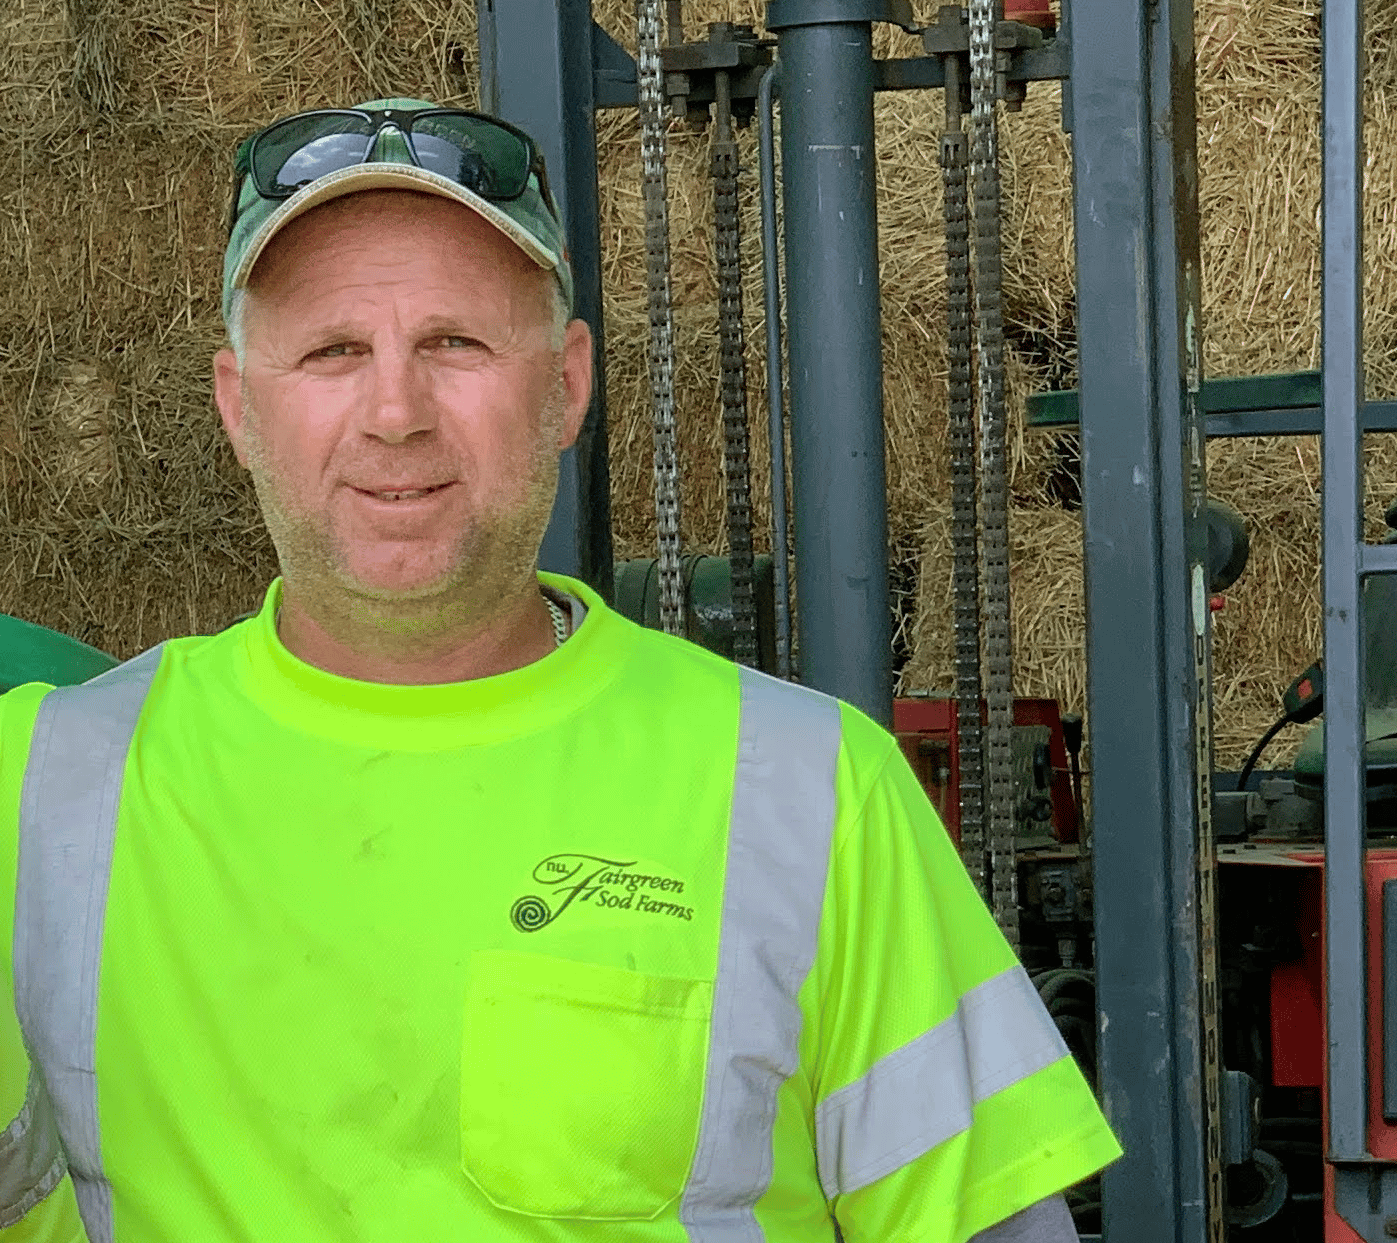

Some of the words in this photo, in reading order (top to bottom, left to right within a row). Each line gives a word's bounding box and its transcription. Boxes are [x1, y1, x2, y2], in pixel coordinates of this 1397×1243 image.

[511, 854, 685, 933] Fairgreen
[595, 889, 635, 910] Sod
[636, 894, 694, 921] Farms
